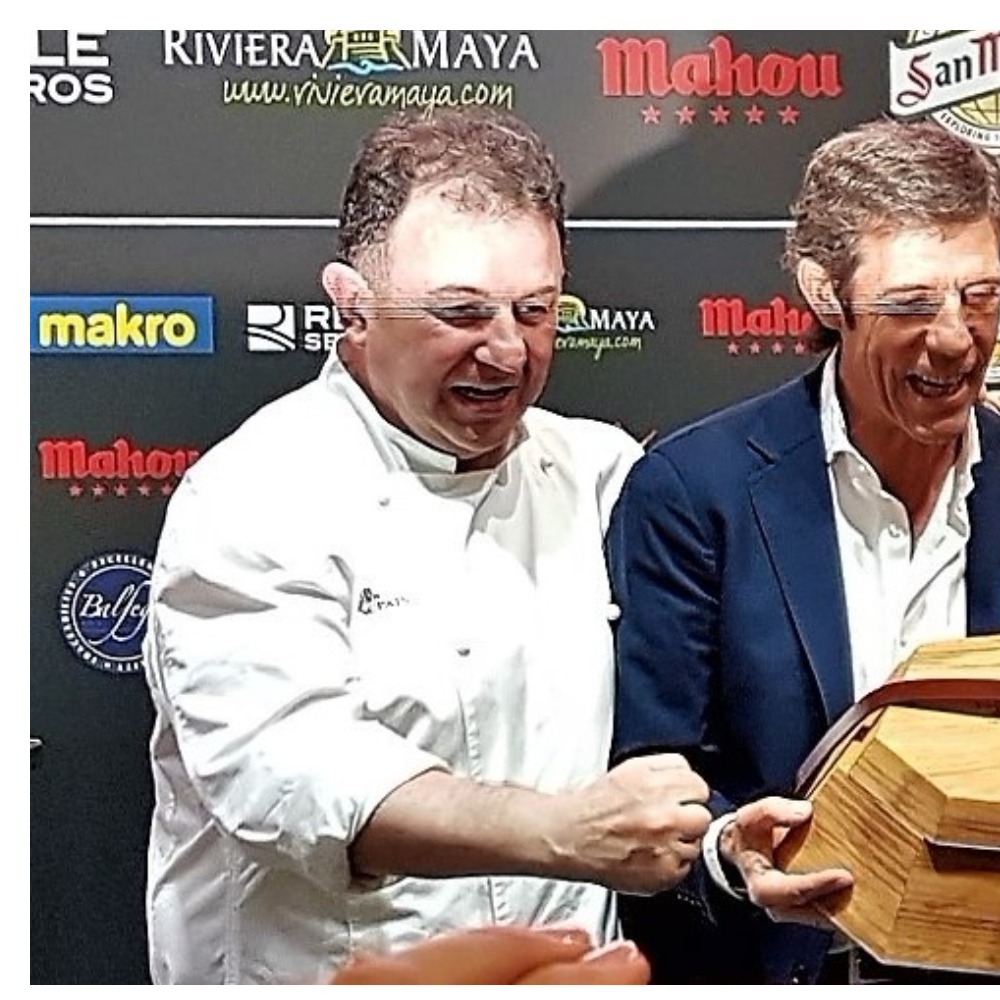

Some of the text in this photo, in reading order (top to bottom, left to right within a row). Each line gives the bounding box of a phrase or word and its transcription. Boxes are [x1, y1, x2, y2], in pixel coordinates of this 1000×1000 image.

[163, 30, 540, 69] RIVIERA MAYA
[596, 36, 842, 97] Mahou
[39, 302, 196, 347] makro
[589, 309, 655, 330] MAYA
